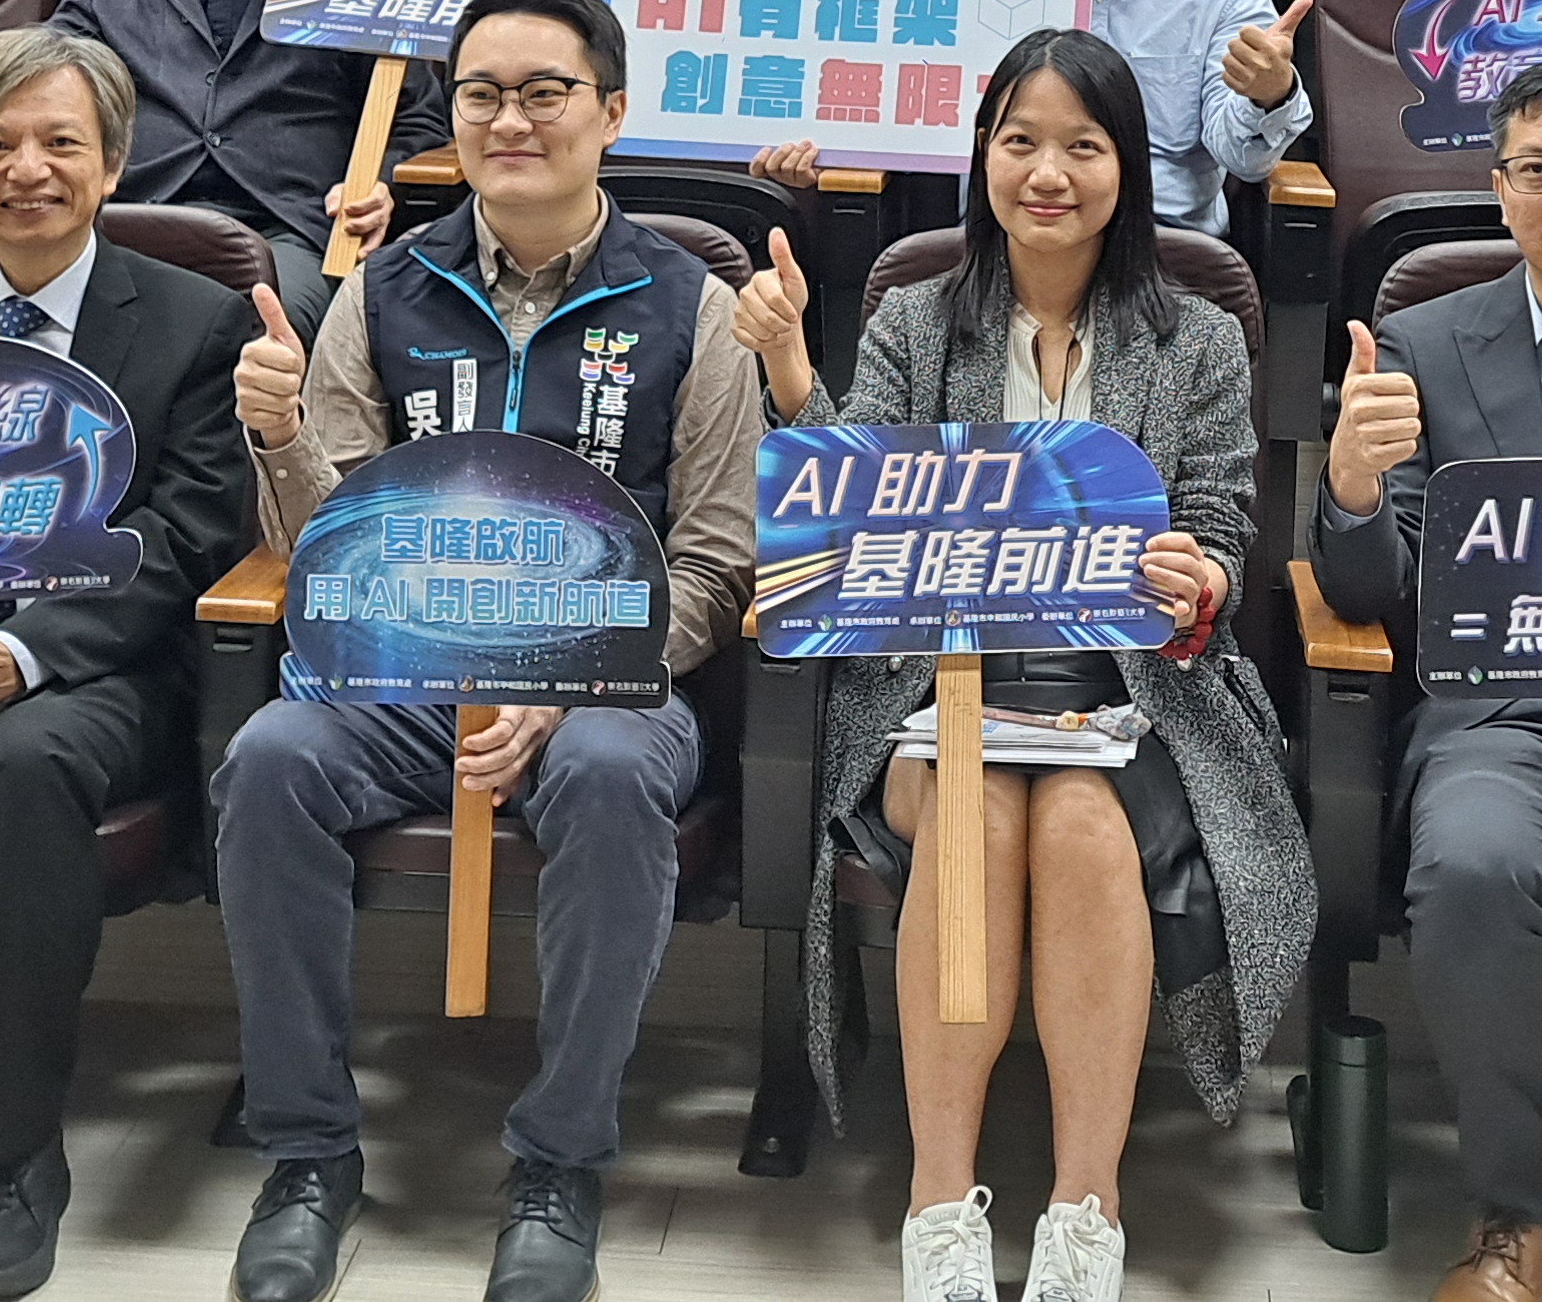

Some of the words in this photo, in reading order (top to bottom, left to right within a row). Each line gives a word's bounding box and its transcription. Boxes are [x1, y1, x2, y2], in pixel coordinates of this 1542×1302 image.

[404, 389, 441, 441] 吳
[577, 383, 597, 435] Keelung
[590, 385, 629, 477] 基隆市
[773, 455, 856, 519] AI
[868, 450, 1023, 517] 助力
[382, 514, 564, 564] 基隆啟航
[1454, 497, 1536, 563] AI
[839, 525, 1143, 599] 基隆前進
[304, 574, 353, 620] 用
[423, 577, 650, 627] 開創新航道
